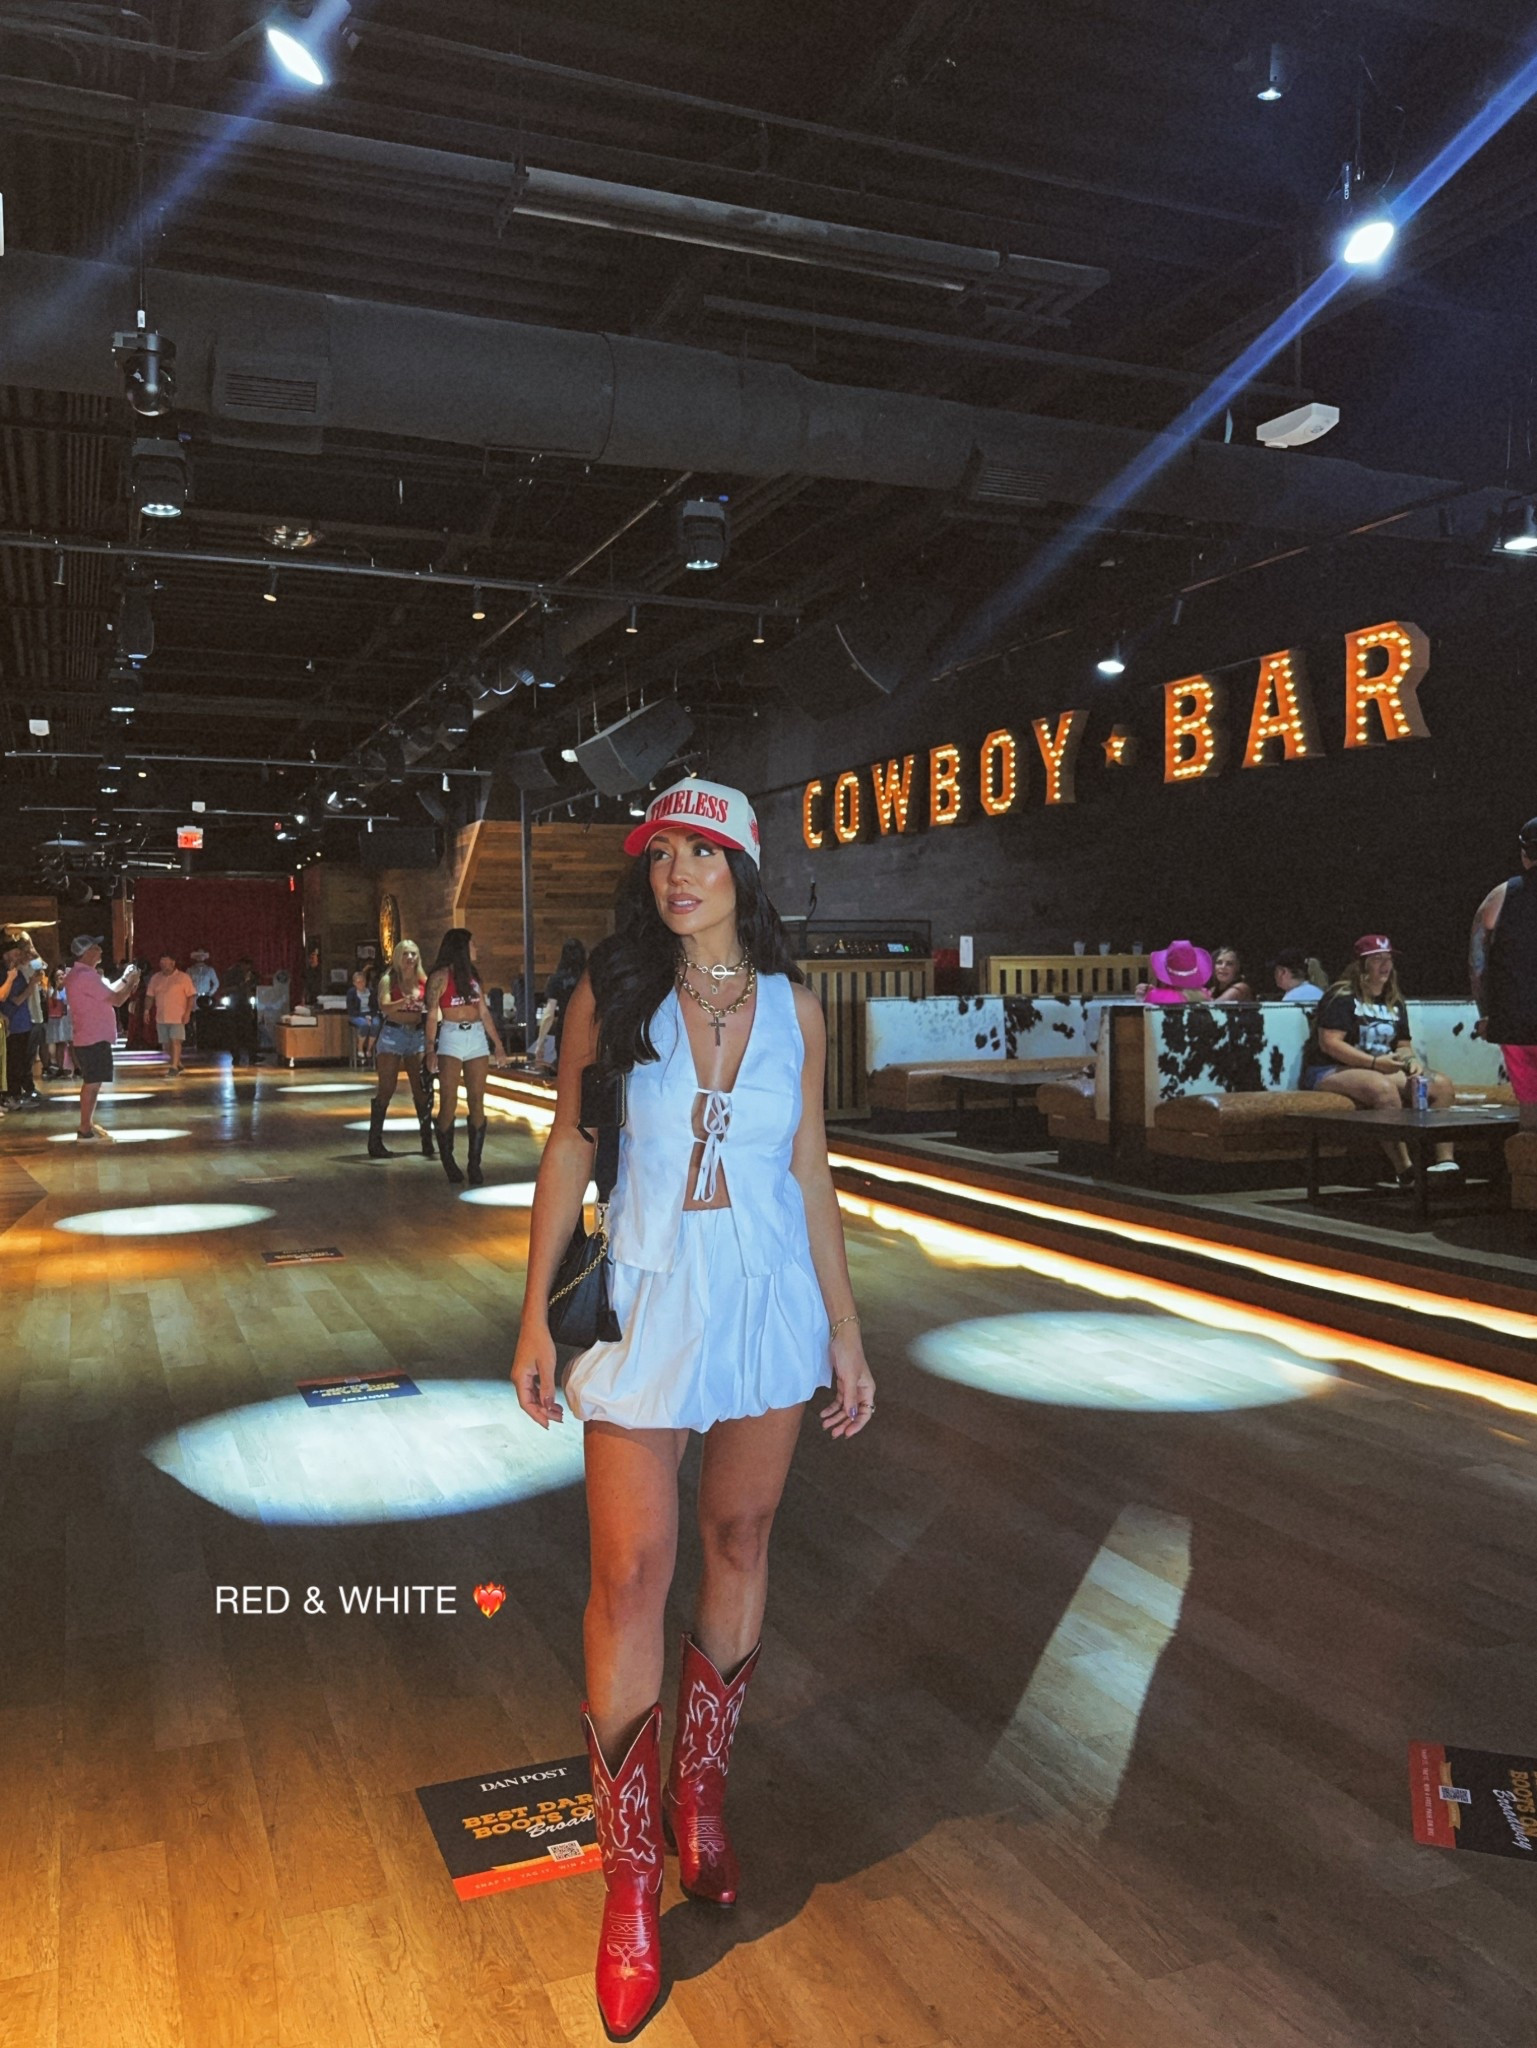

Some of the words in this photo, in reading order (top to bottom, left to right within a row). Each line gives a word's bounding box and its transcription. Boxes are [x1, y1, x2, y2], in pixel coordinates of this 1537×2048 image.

[803, 710, 1086, 848] COWBOY
[1163, 621, 1430, 784] BAR
[651, 790, 729, 823] TIMELESS
[480, 1778, 519, 1792] DAN
[520, 1767, 568, 1784] POST
[462, 1806, 528, 1829] BEST
[537, 1793, 593, 1814] DAR
[473, 1811, 563, 1839] BOOTS
